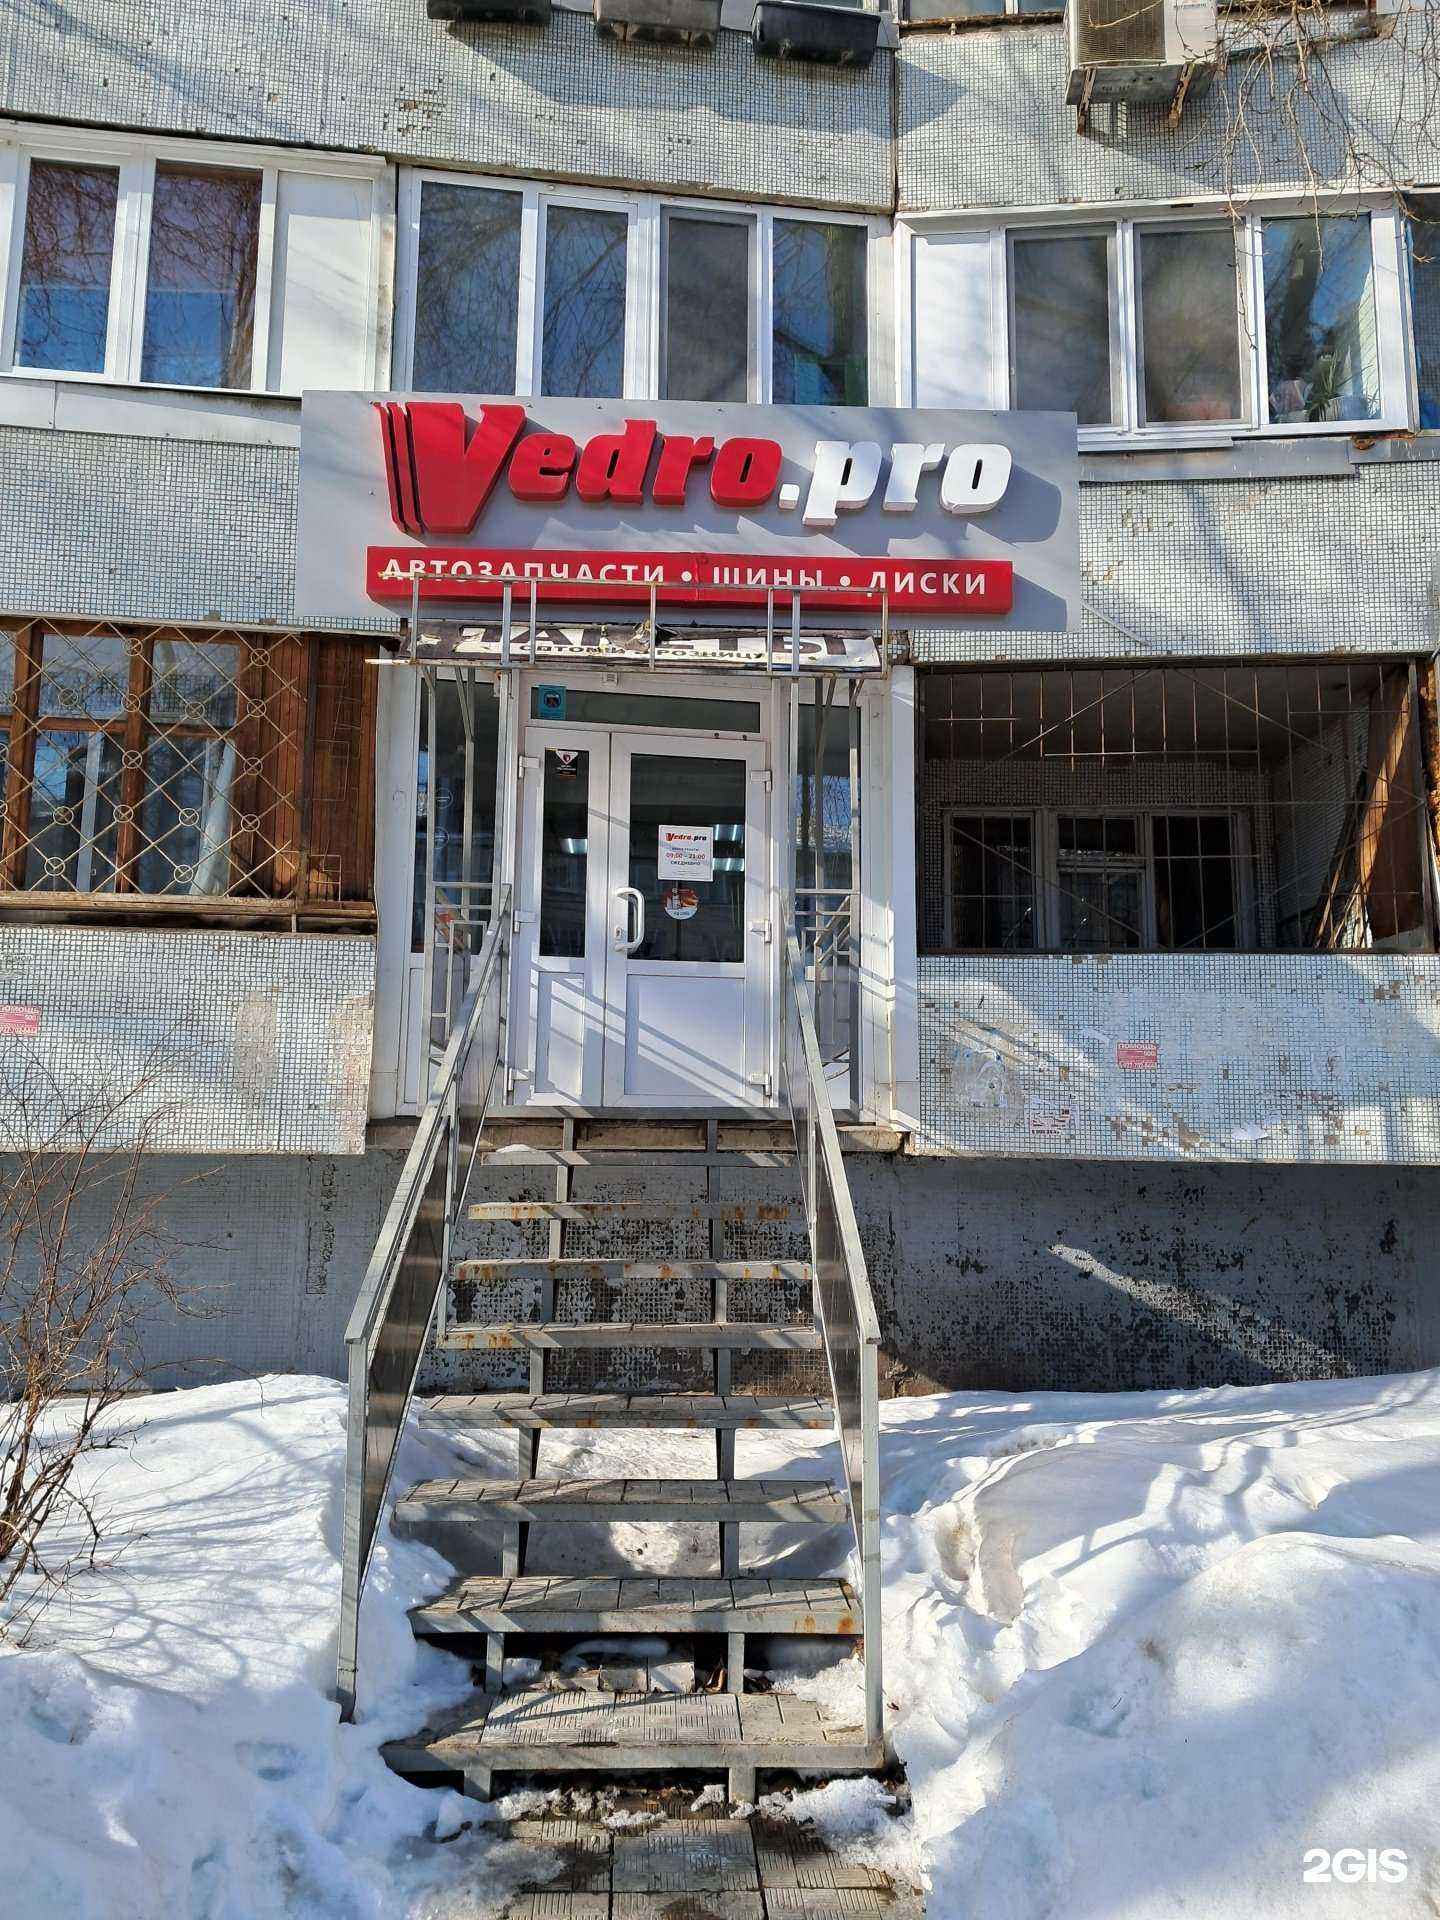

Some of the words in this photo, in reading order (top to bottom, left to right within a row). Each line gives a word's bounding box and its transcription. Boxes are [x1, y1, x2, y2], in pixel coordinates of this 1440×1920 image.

[373, 402, 1013, 533] Vedro.pro
[381, 557, 664, 582] АВТОЗАПЧАСТИ
[713, 566, 823, 587] ШИНЫ
[867, 570, 986, 597] ДИСКИ
